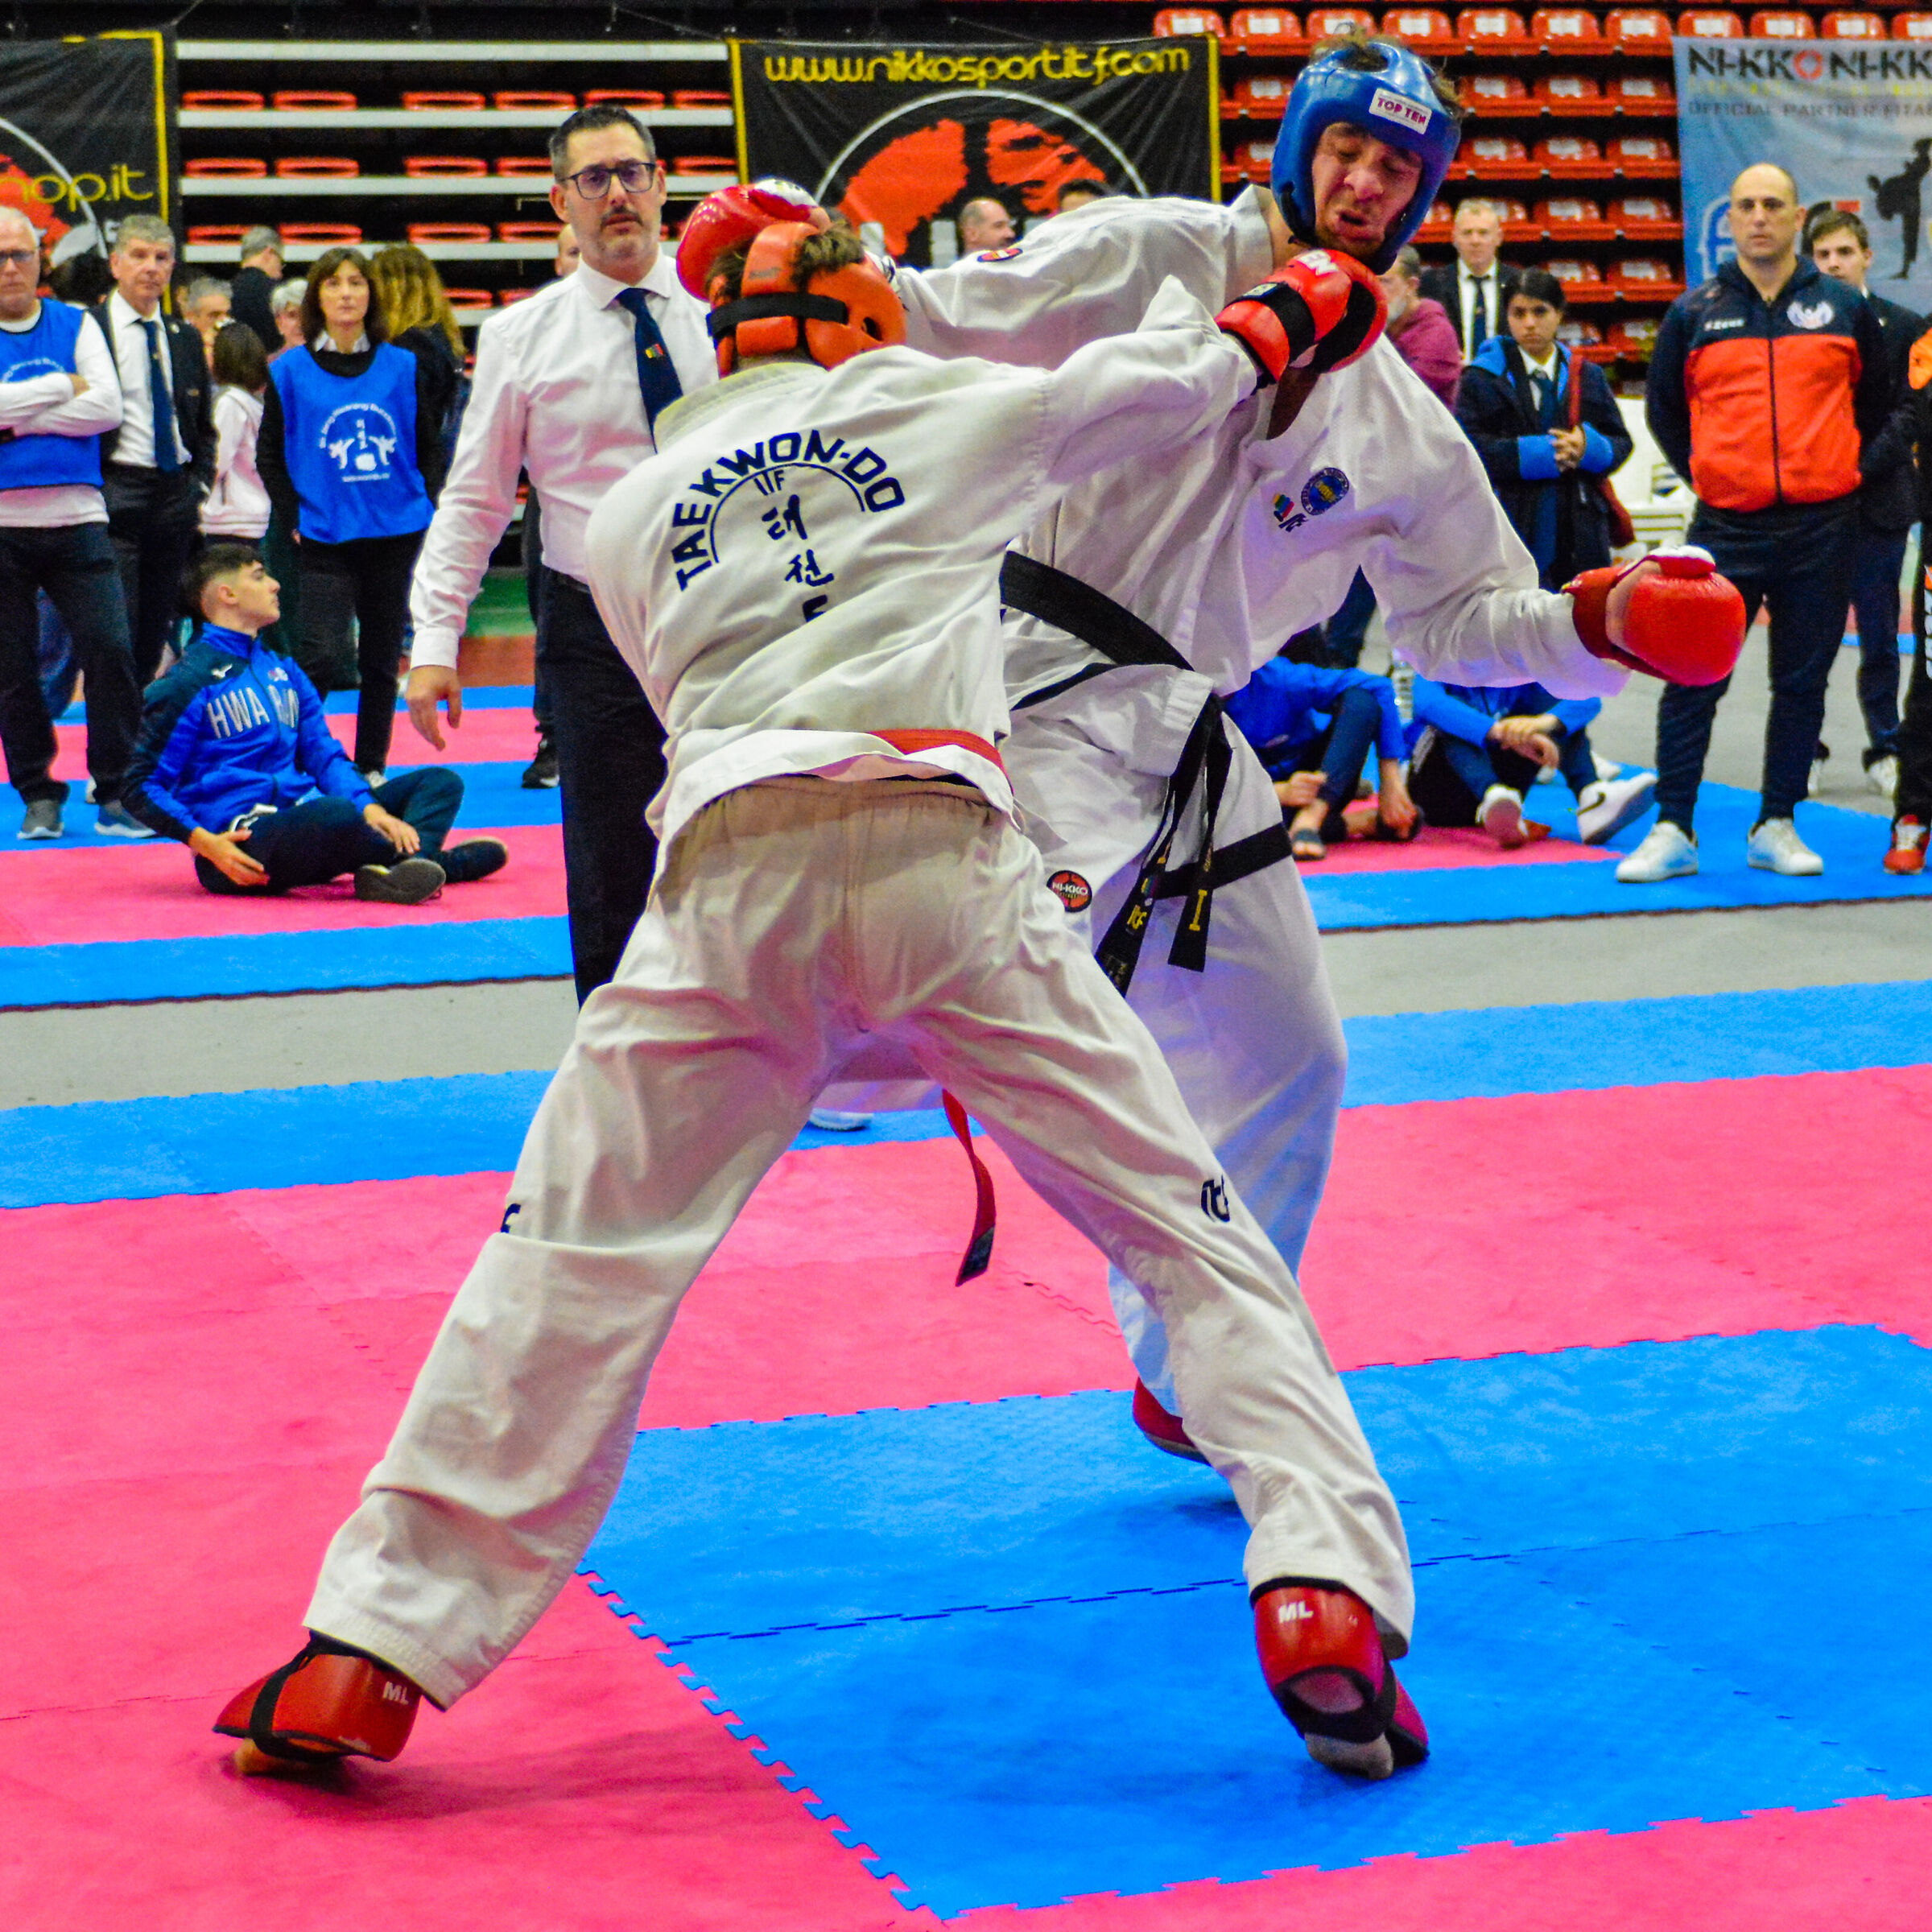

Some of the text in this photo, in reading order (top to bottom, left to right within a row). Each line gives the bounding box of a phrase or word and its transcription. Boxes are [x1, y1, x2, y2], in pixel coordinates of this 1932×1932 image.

[1377, 97, 1427, 126] TOP TEN
[671, 429, 906, 592] TAEKWON-DO
[1278, 1600, 1314, 1624] ML
[382, 1681, 409, 1706] ML
